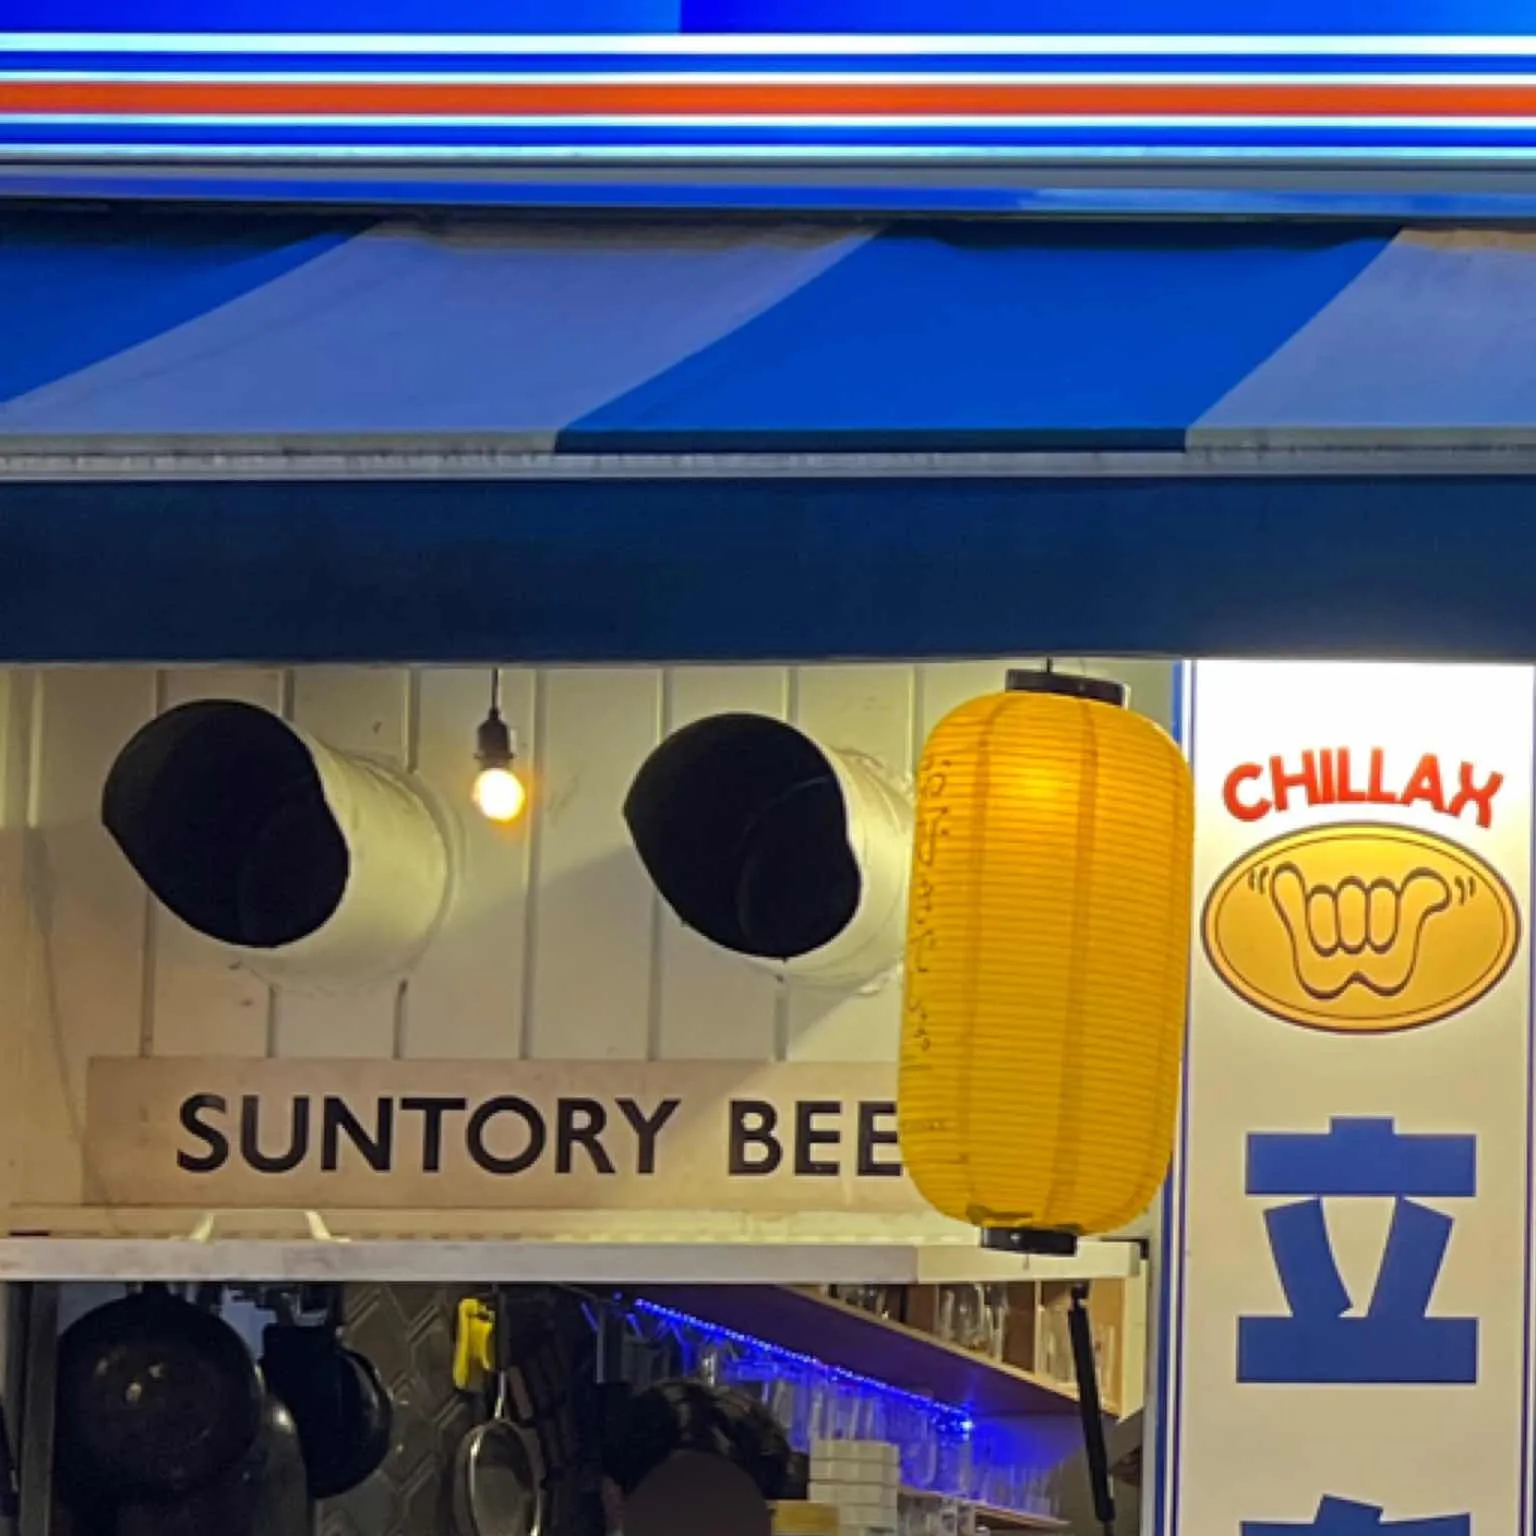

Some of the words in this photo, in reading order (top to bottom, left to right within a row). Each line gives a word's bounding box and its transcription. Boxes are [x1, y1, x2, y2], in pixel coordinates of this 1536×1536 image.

[1222, 746, 1505, 828] CHILLAX
[176, 1093, 681, 1176] SUNTORY
[729, 1098, 905, 1177] BEE
